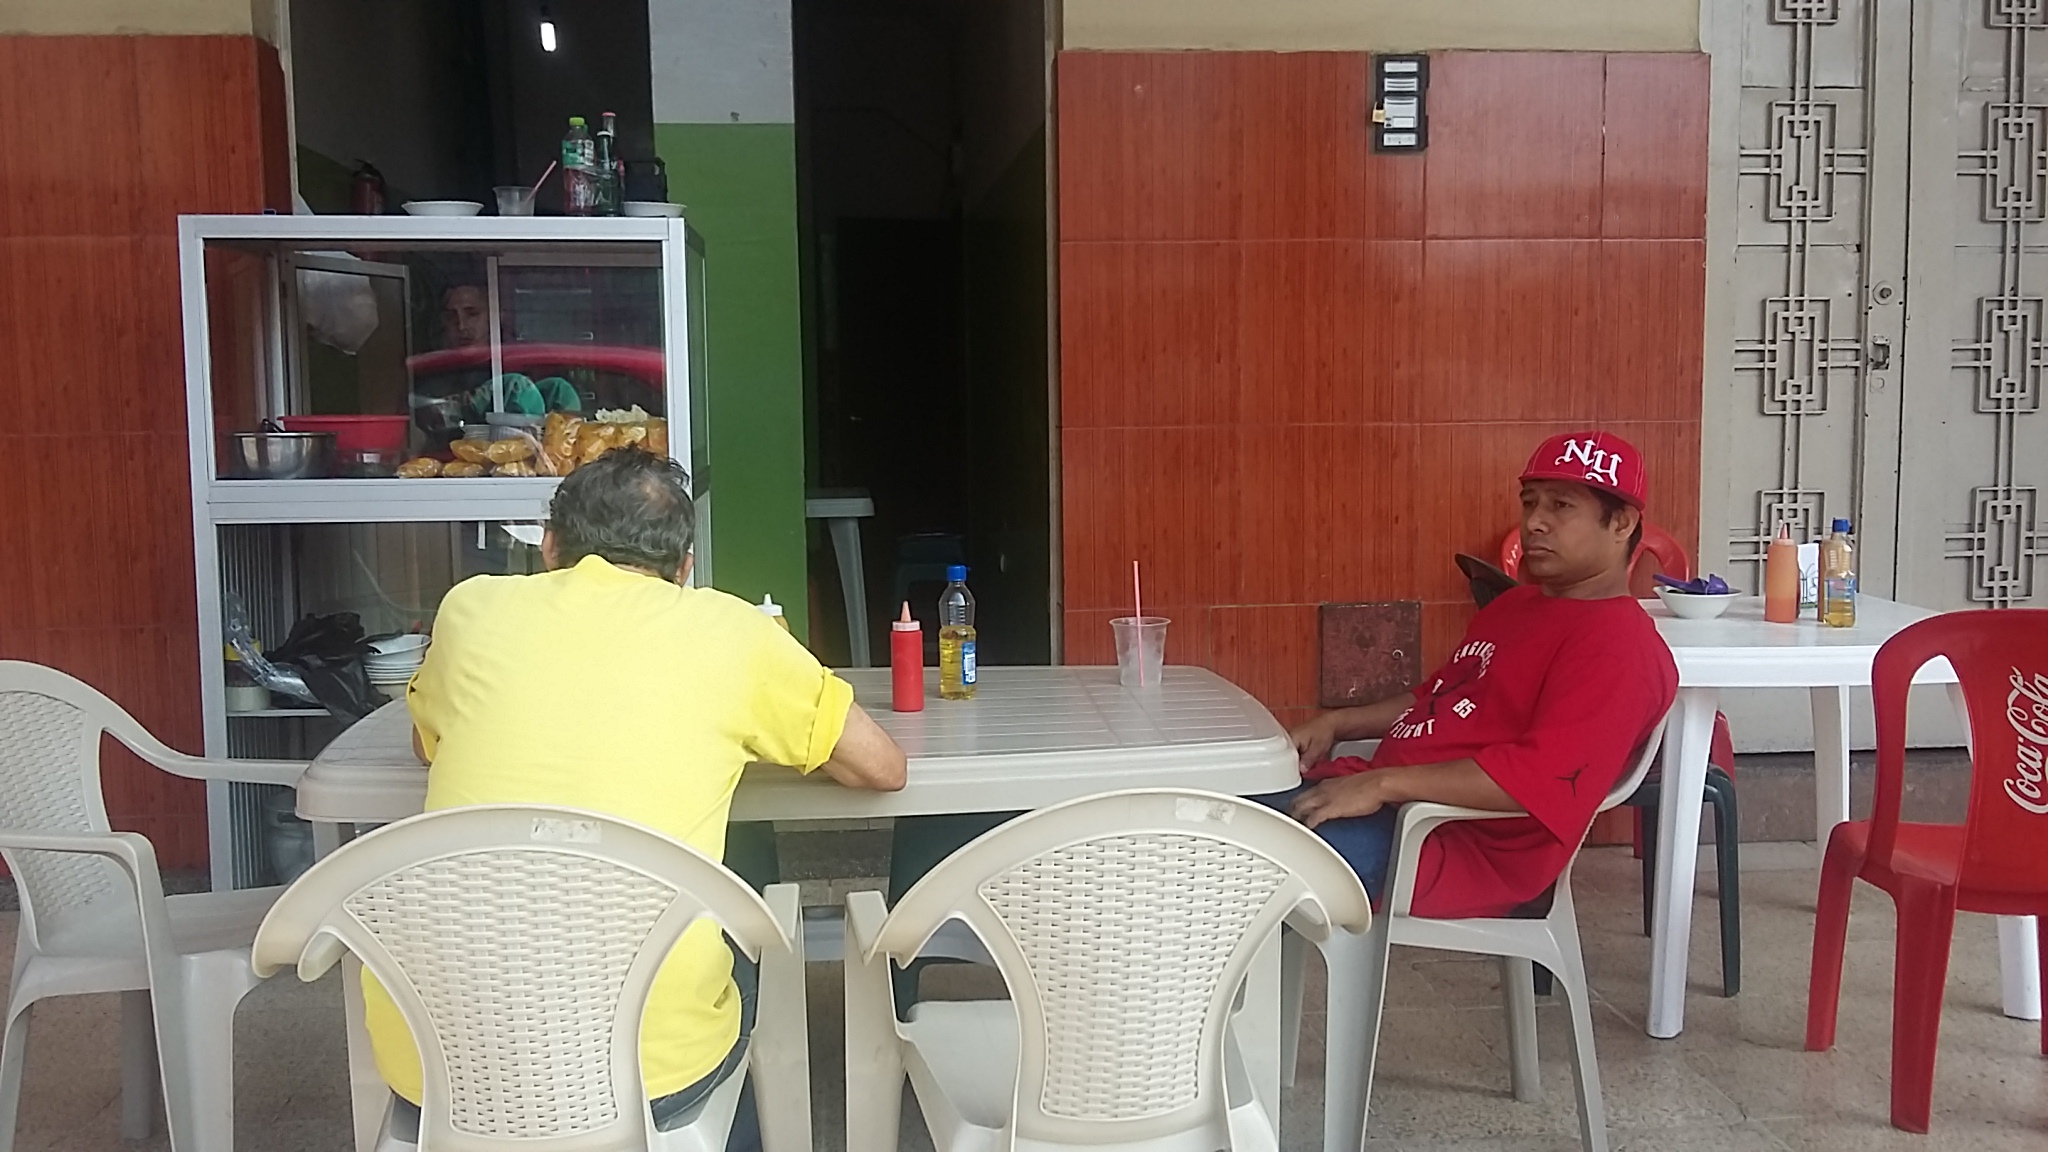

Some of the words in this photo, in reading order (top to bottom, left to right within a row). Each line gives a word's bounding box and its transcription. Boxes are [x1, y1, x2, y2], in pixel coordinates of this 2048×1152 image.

[1554, 438, 1623, 487] NY
[1452, 697, 1477, 719] 85
[1389, 718, 1436, 739] FLIGHT
